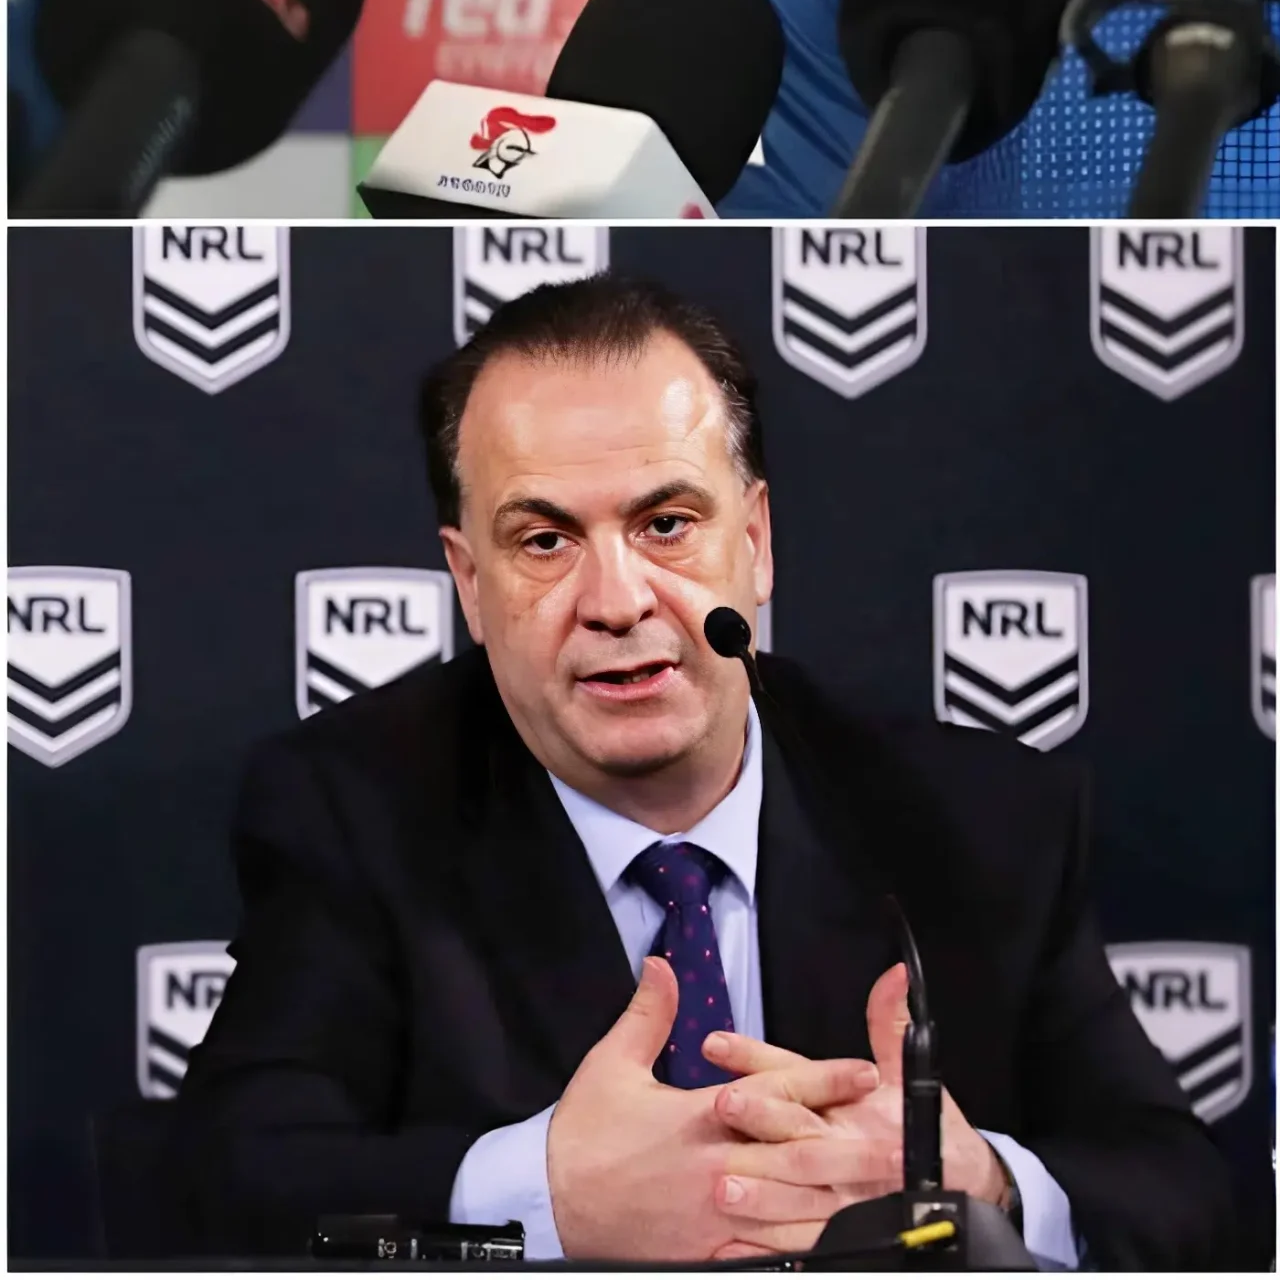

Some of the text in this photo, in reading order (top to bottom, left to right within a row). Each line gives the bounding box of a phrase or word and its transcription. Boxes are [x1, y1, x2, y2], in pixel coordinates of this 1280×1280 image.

[161, 226, 265, 261] NRL
[482, 226, 585, 264] NRL
[800, 228, 904, 267] NRL
[1117, 231, 1220, 270] NRL
[323, 597, 429, 636] NRL
[961, 599, 1065, 639] NRL
[1122, 970, 1228, 1011] NRL
